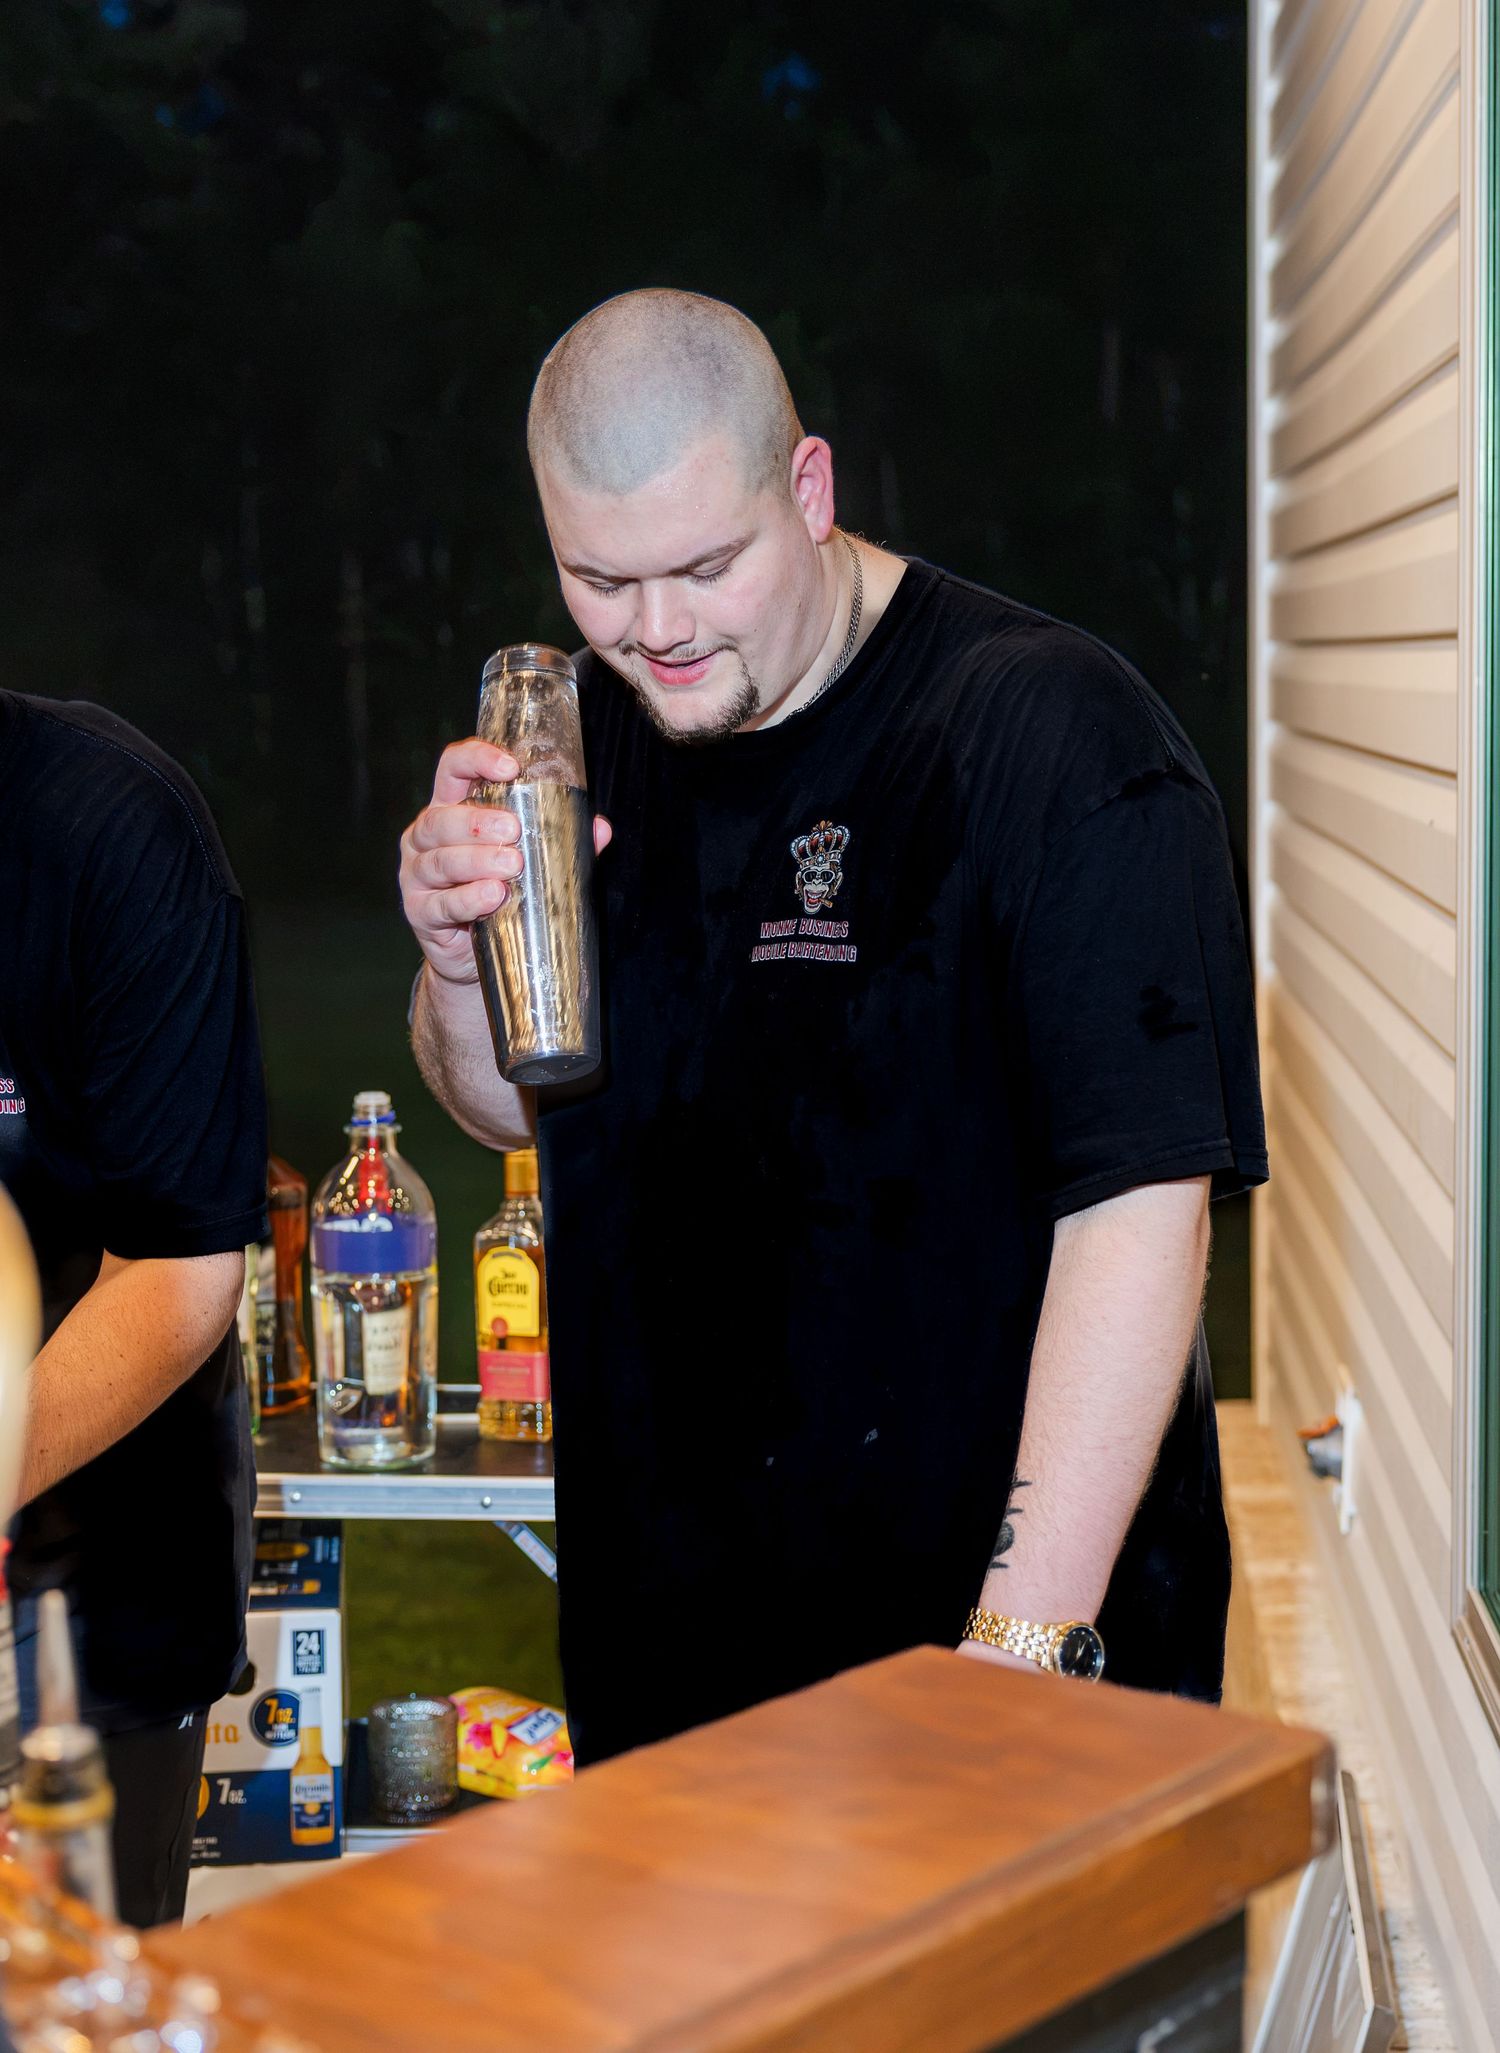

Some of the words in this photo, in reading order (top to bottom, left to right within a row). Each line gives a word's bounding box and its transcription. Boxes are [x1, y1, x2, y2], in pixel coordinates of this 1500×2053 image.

[751, 942, 787, 962] MOBILE
[788, 942, 857, 962] BARTENDING
[296, 1631, 321, 1656] 24
